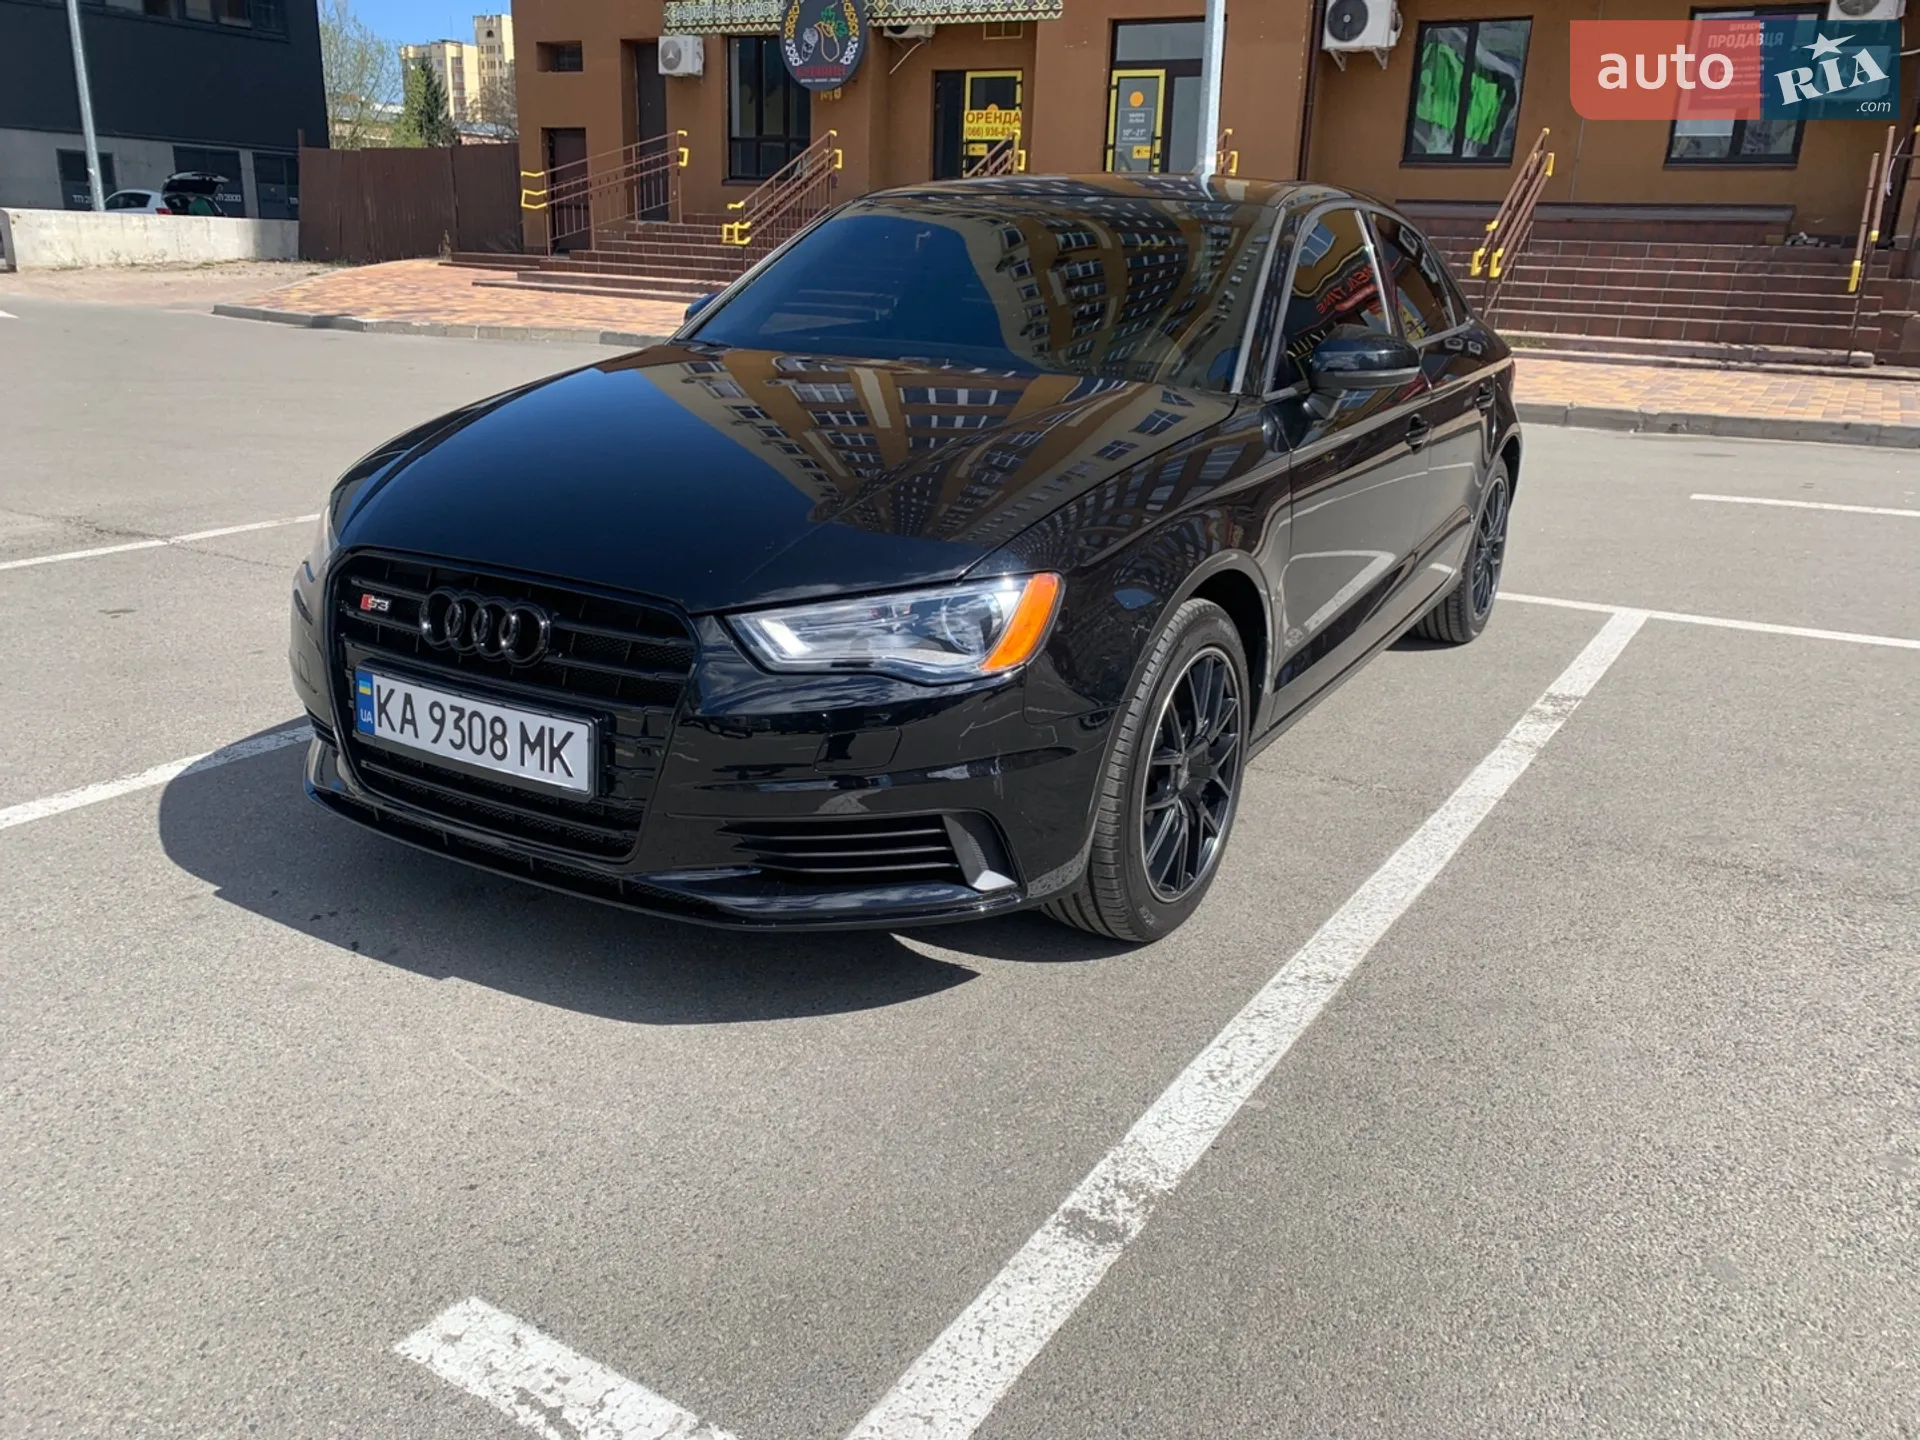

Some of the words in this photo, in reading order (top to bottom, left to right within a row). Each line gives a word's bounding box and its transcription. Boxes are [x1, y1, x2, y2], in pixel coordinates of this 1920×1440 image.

[1708, 32, 1784, 48] ПРОДАВЦЯ
[966, 112, 1021, 125] ОРЕНДА
[360, 708, 374, 724] UA
[376, 684, 419, 739] KA
[428, 700, 508, 762] 9308
[519, 720, 575, 778] MK
